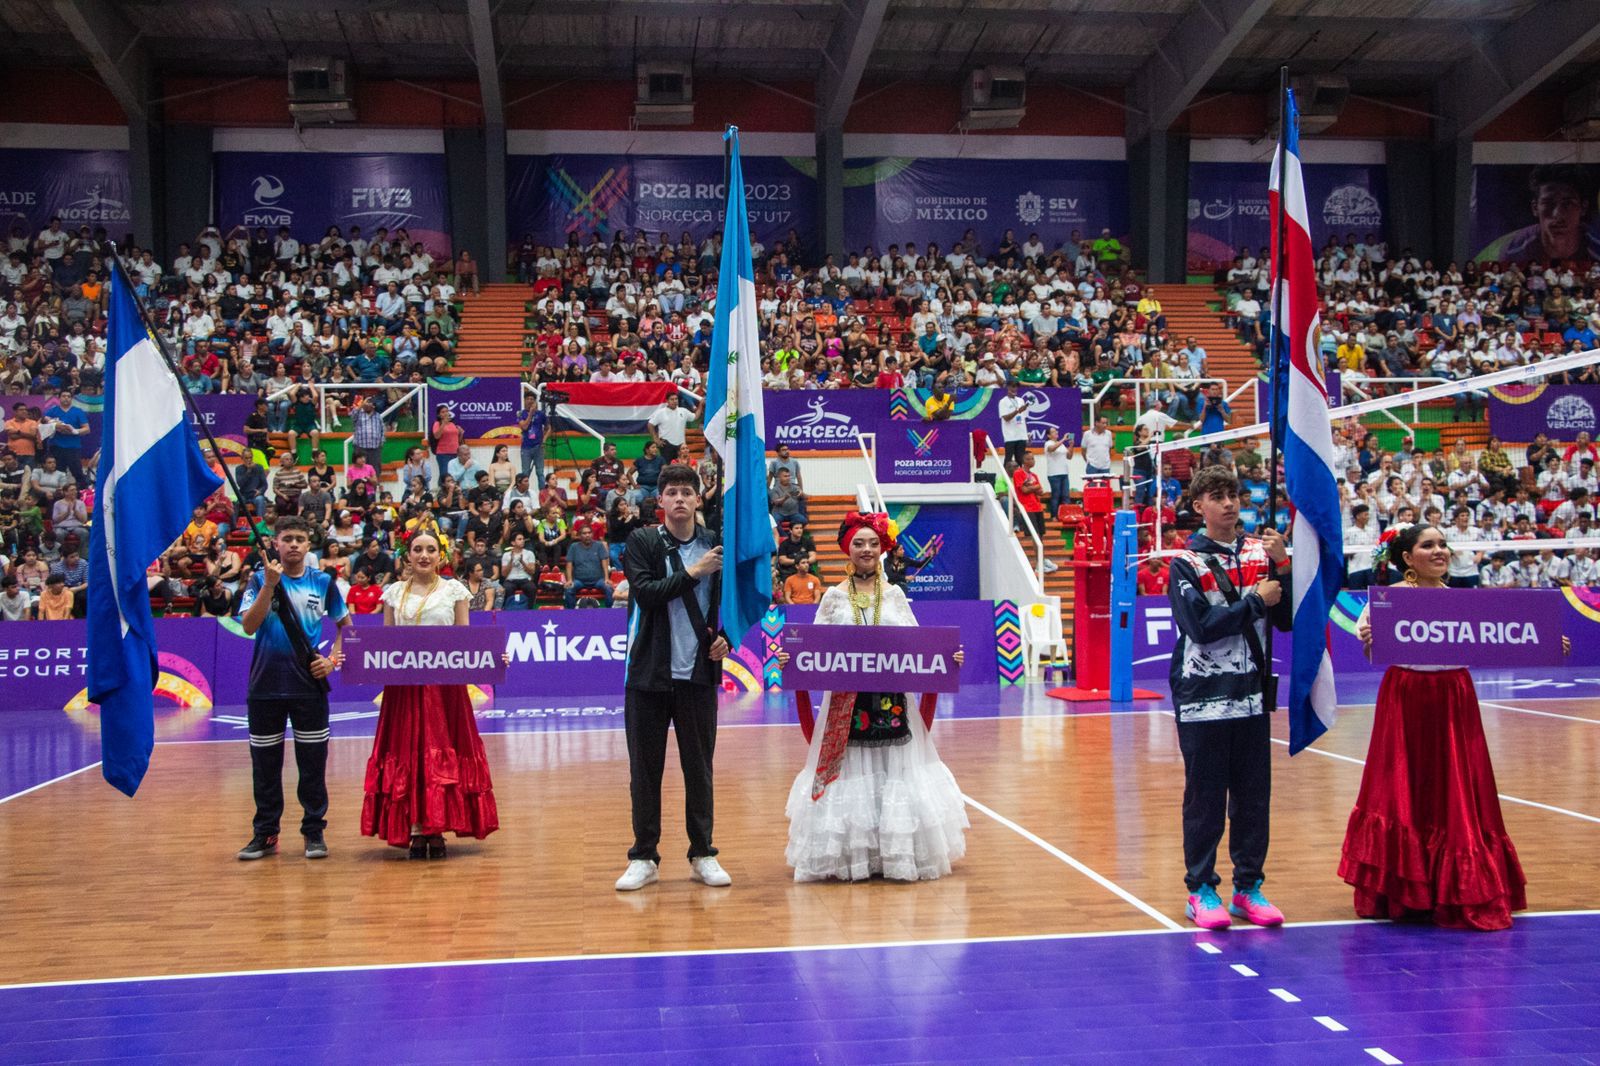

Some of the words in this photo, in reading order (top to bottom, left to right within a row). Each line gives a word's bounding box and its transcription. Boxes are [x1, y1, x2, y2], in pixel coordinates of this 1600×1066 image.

[351, 187, 413, 209] FIVB
[744, 184, 792, 201] 2023
[915, 196, 971, 206] GOBIERNO
[973, 196, 988, 206] DE
[1048, 198, 1079, 210] SEV
[57, 207, 131, 220] NORCECA
[915, 204, 988, 221] MÉXICO
[1238, 204, 1270, 216] POZA
[243, 214, 292, 226] FMVB
[764, 211, 792, 223] U17
[1323, 215, 1382, 226] VERACRUZ
[460, 402, 513, 412] CONADE
[1546, 420, 1596, 430] VERACRUZ
[775, 424, 860, 439] NORCECA
[933, 459, 952, 467] 2023
[934, 574, 954, 583] 2023
[1394, 620, 1476, 644] COSTA
[1479, 622, 1540, 645] RICA
[363, 650, 496, 669] NICARAGUA
[795, 651, 948, 674] GUATEMALA
